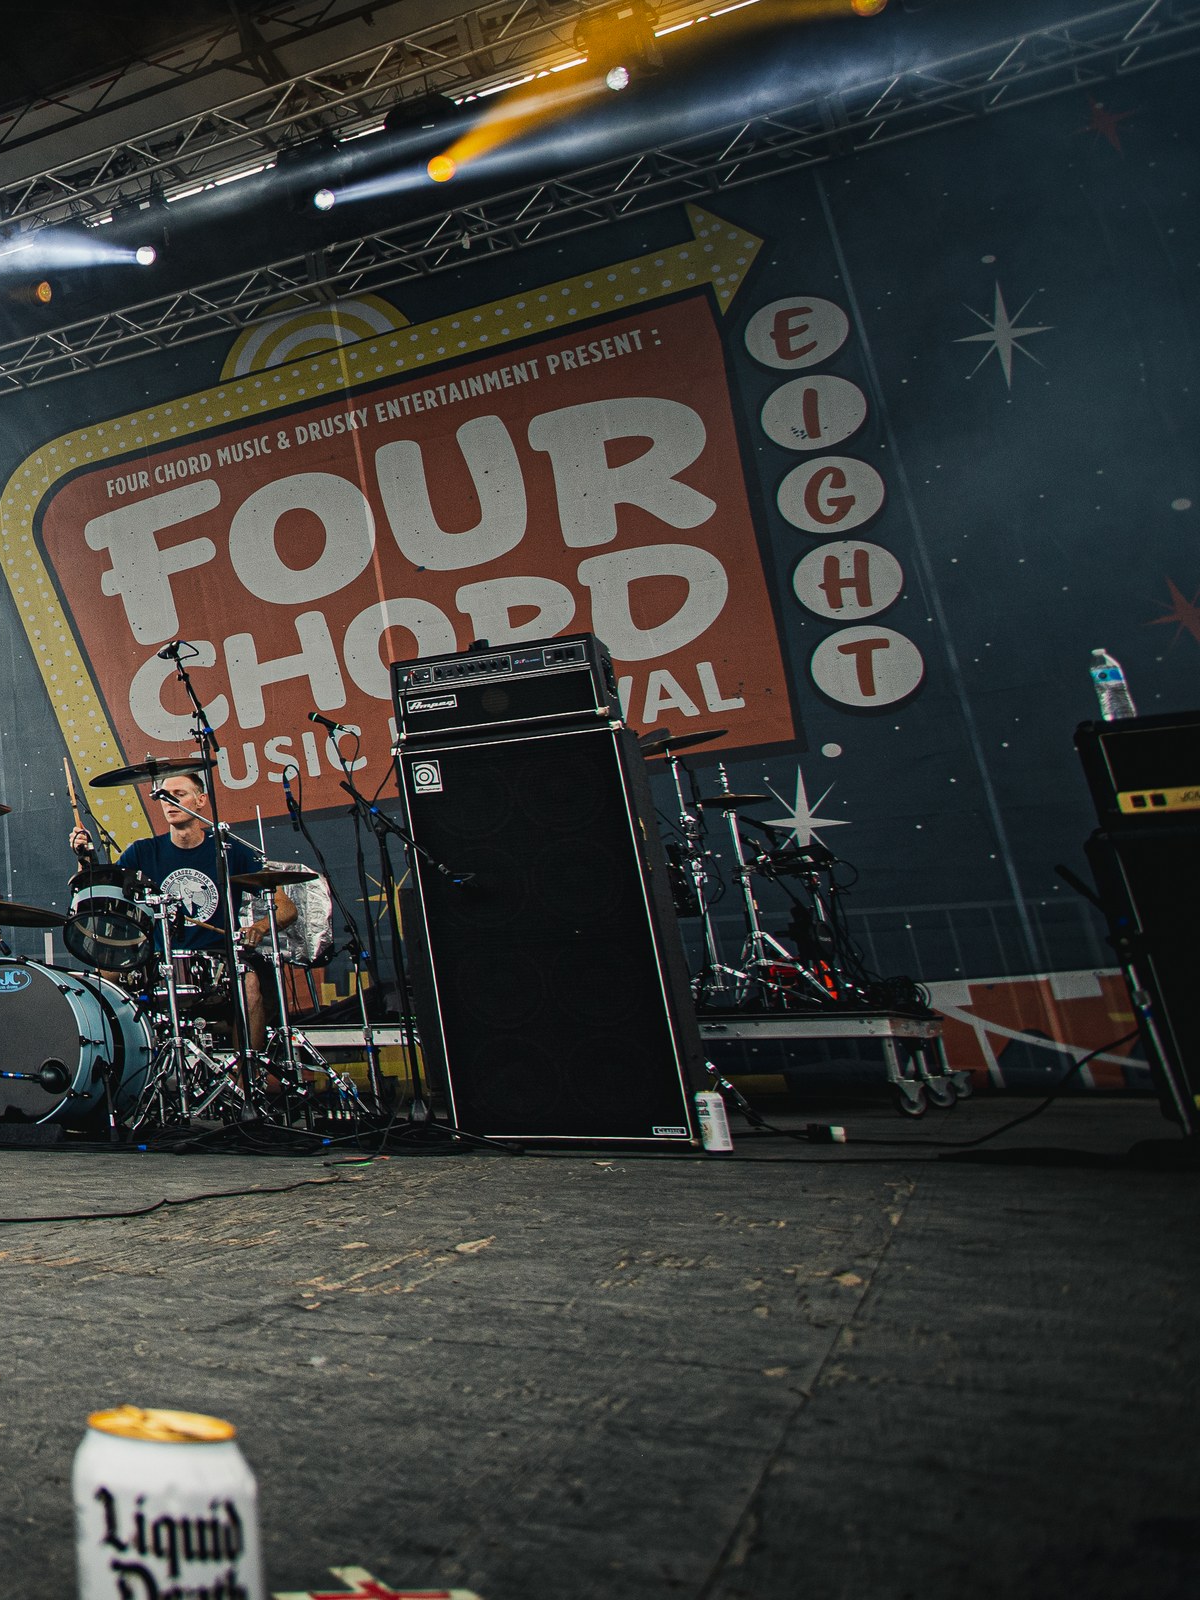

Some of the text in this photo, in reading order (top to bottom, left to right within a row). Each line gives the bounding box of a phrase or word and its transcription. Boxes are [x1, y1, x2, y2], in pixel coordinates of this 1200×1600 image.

[106, 471, 150, 498] FOUR
[154, 453, 212, 484] CHORD
[217, 435, 272, 467] MUSIC
[276, 430, 291, 450] &
[295, 407, 369, 446] DRUSKY
[374, 358, 541, 423] ENTERTAINMENT
[84, 397, 718, 646] FOUR
[409, 700, 456, 711] Ampeg
[155, 724, 369, 794] USIC
[168, 870, 193, 881] WEASEL
[194, 872, 211, 885] PUNK
[94, 1485, 245, 1578] Liquid
